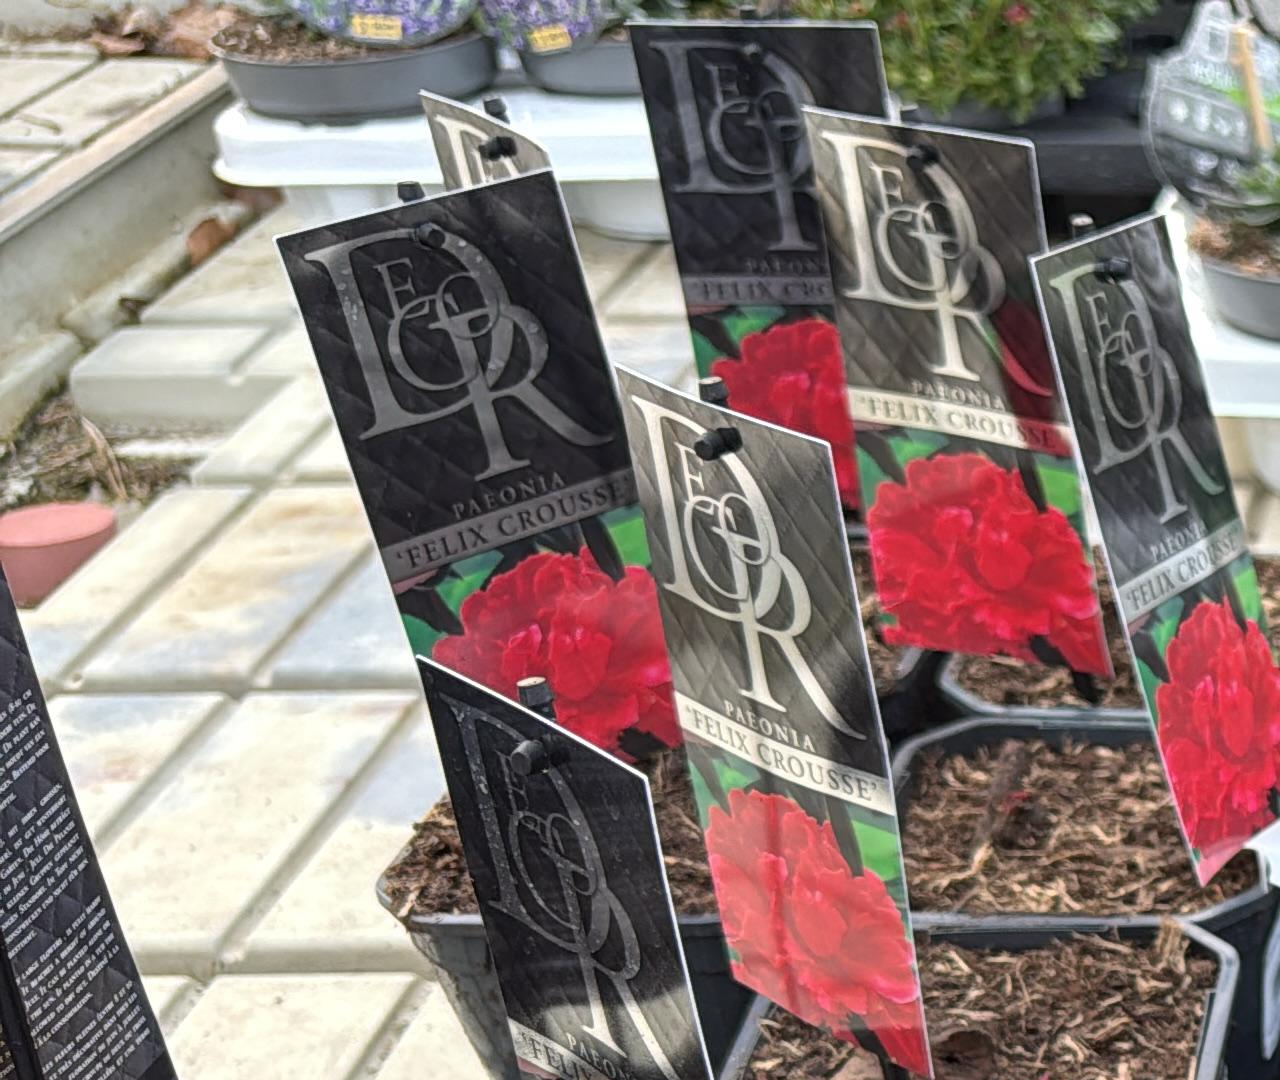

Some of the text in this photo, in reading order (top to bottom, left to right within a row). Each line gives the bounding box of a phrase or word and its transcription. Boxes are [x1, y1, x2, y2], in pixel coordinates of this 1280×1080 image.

[912, 379, 1007, 412] PAEONIA
[397, 473, 632, 570] 'FELIX CROUSSE'
[453, 470, 567, 521] PAEONIA
[724, 700, 816, 752] PAEONIA
[686, 705, 878, 802] 'FELIX CROUSSE'
